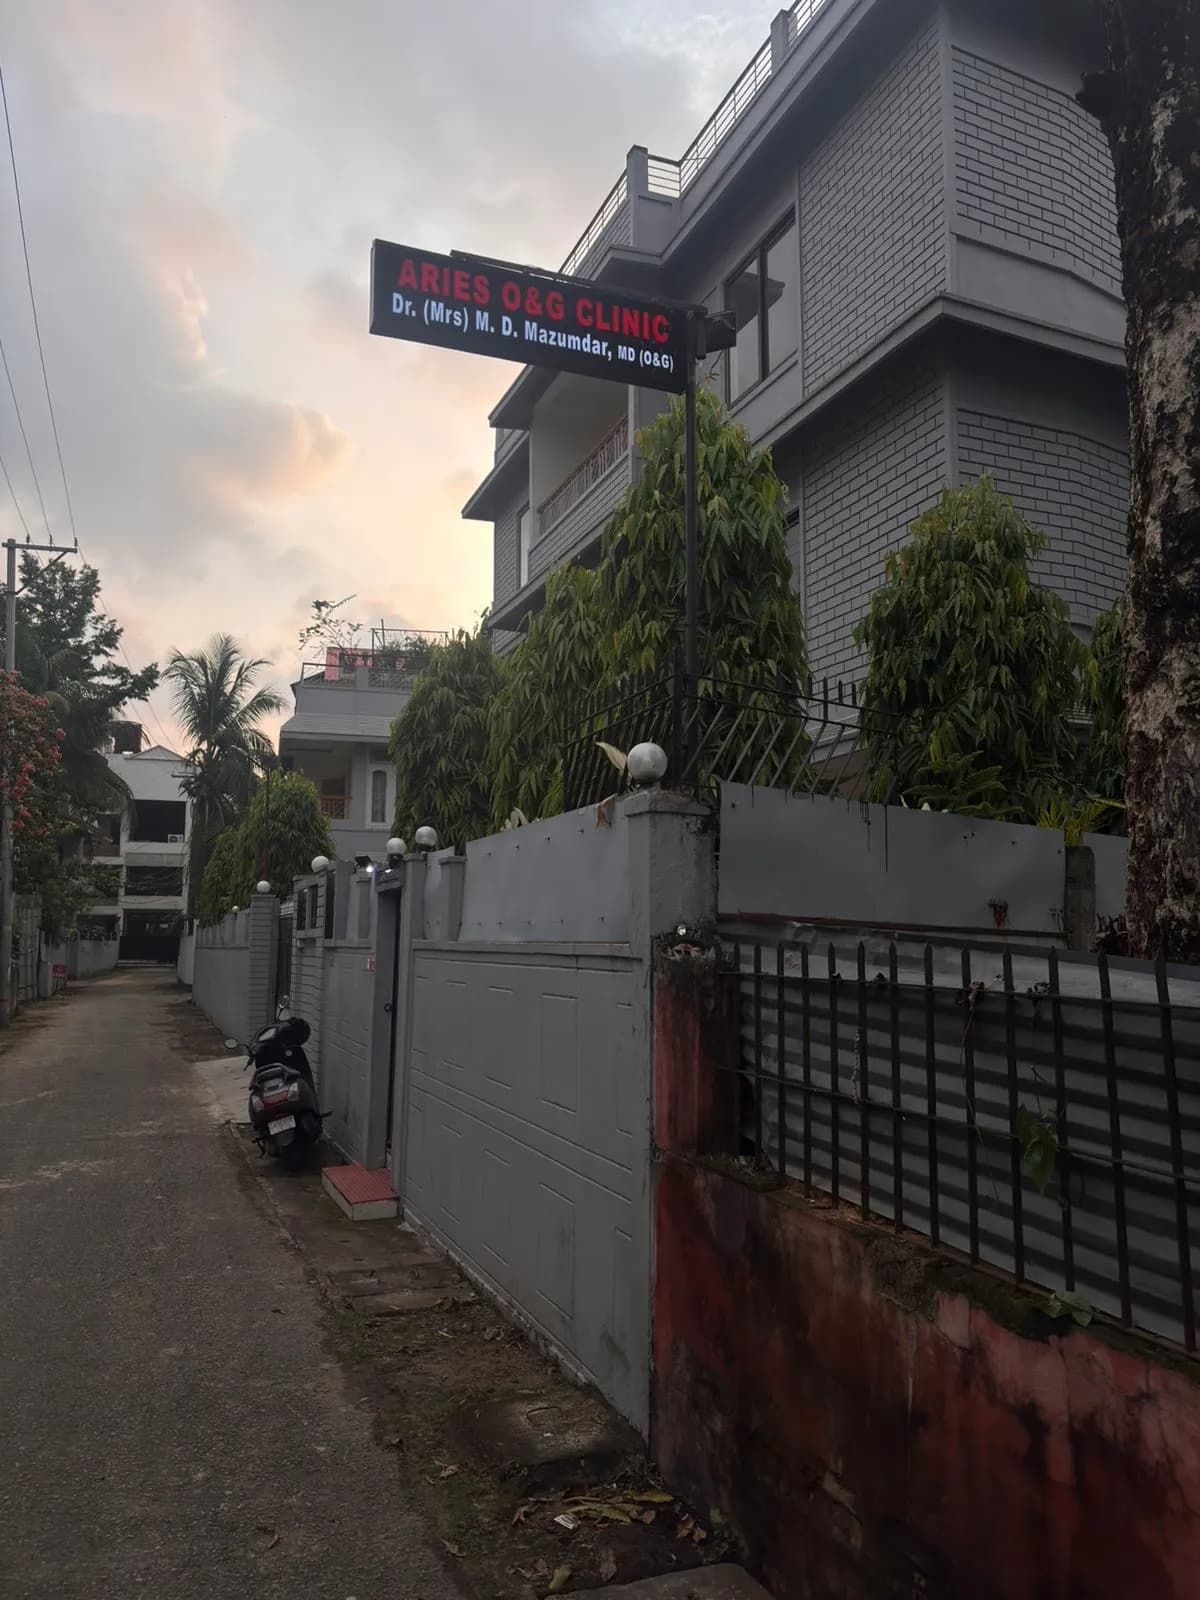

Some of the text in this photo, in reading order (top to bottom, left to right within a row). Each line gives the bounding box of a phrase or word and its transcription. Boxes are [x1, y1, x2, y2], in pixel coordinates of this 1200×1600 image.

[392, 293, 674, 373] Dr. (Mrs) M. D. Mazumdar, MD (O&G)
[398, 259, 670, 343] ARIES O&G CLINIC
